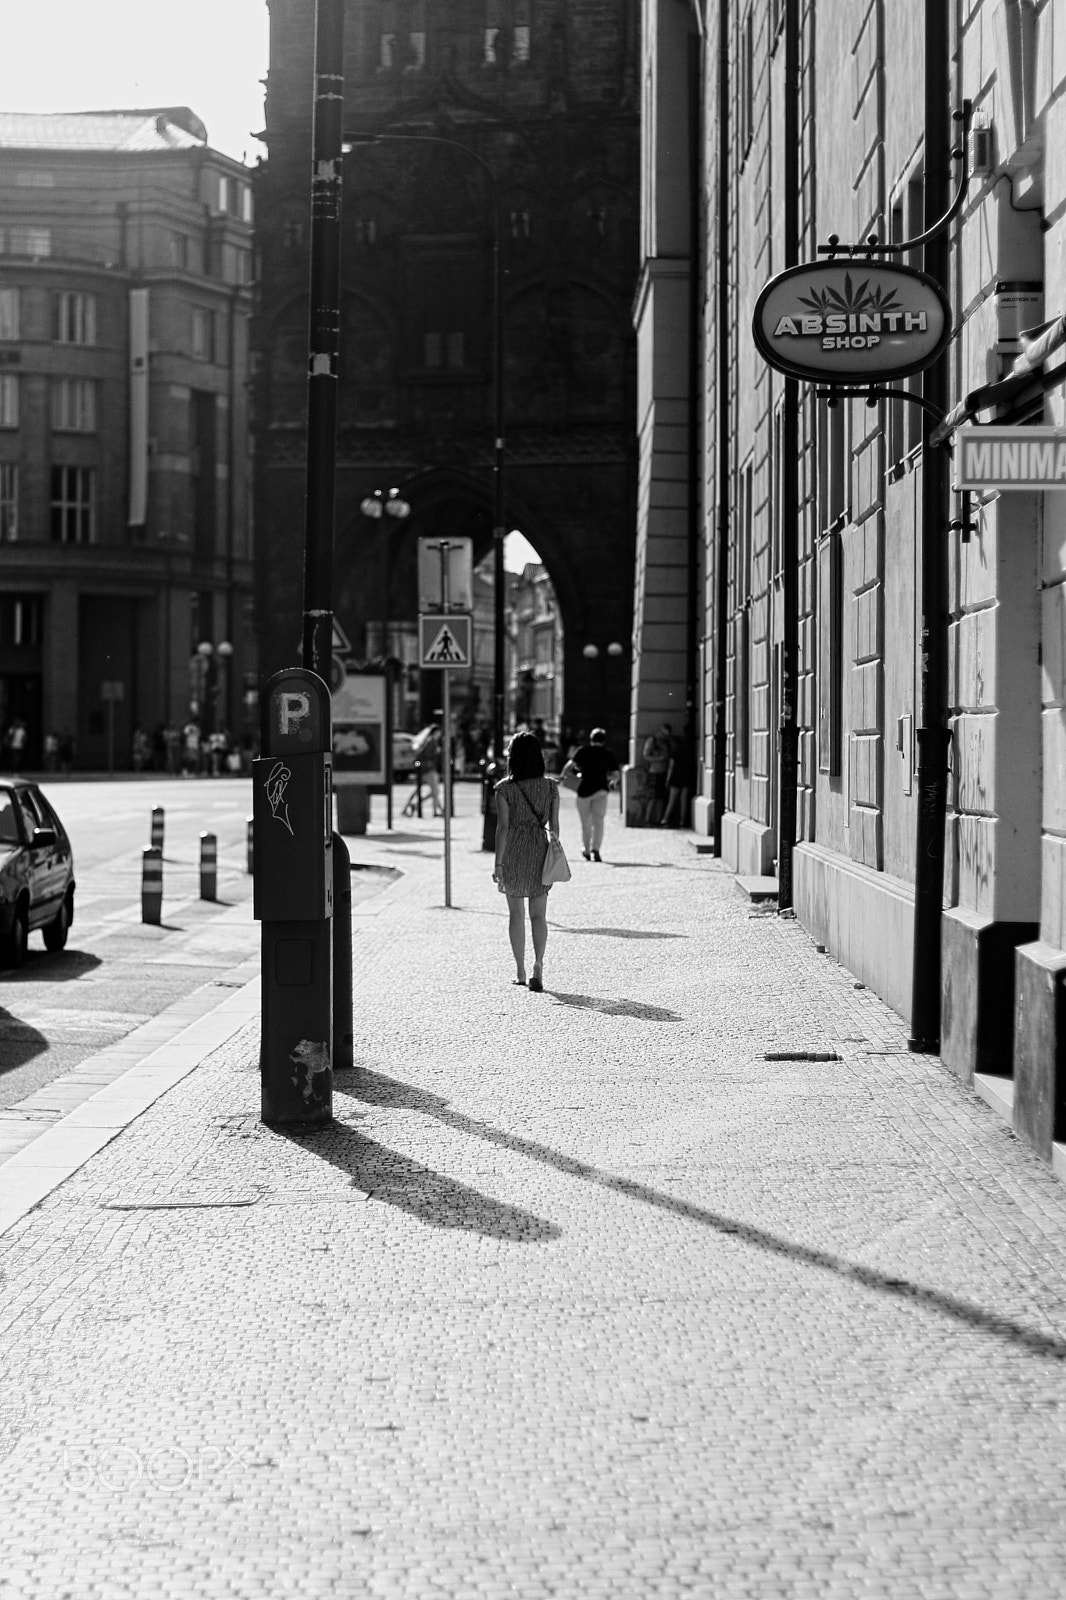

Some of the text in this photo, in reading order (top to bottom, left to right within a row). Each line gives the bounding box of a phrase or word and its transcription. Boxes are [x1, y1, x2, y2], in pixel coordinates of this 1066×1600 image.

[774, 311, 928, 336] ABSINTH
[822, 336, 881, 350] SHOP
[279, 692, 310, 735] P
